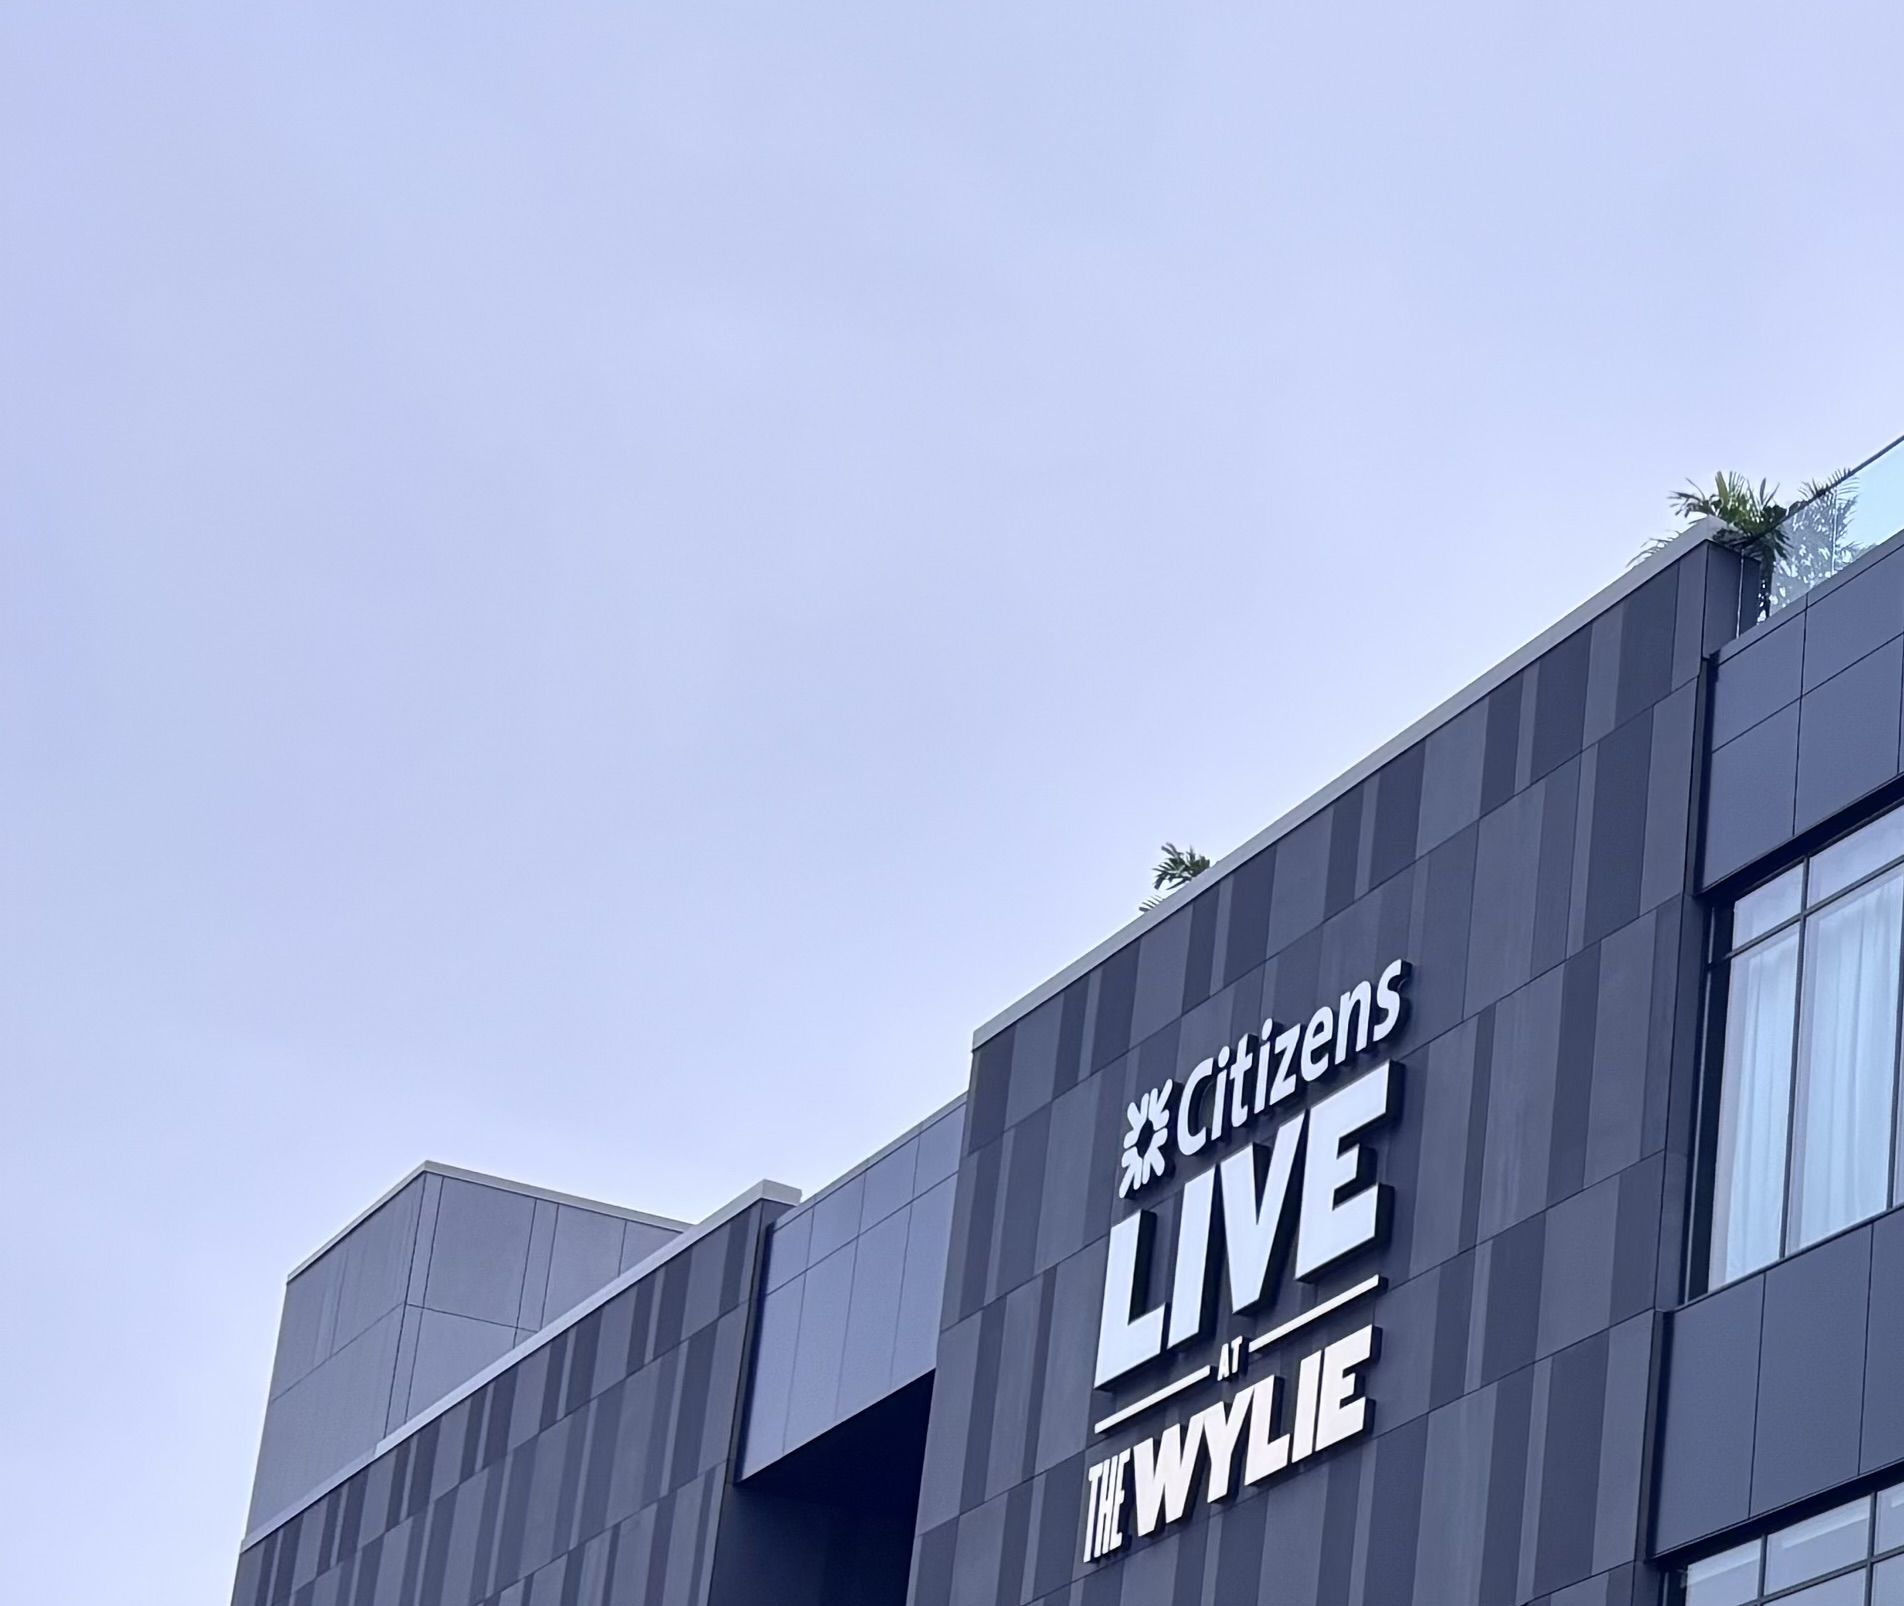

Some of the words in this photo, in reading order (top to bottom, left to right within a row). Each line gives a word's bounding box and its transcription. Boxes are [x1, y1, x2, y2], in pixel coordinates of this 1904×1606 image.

[1177, 958, 1404, 1157] Citizens
[1094, 1060, 1392, 1389] LIVE
[1083, 1448, 1133, 1563] THE
[1133, 1324, 1374, 1537] WYLIE
[1217, 1336, 1242, 1381] AT
